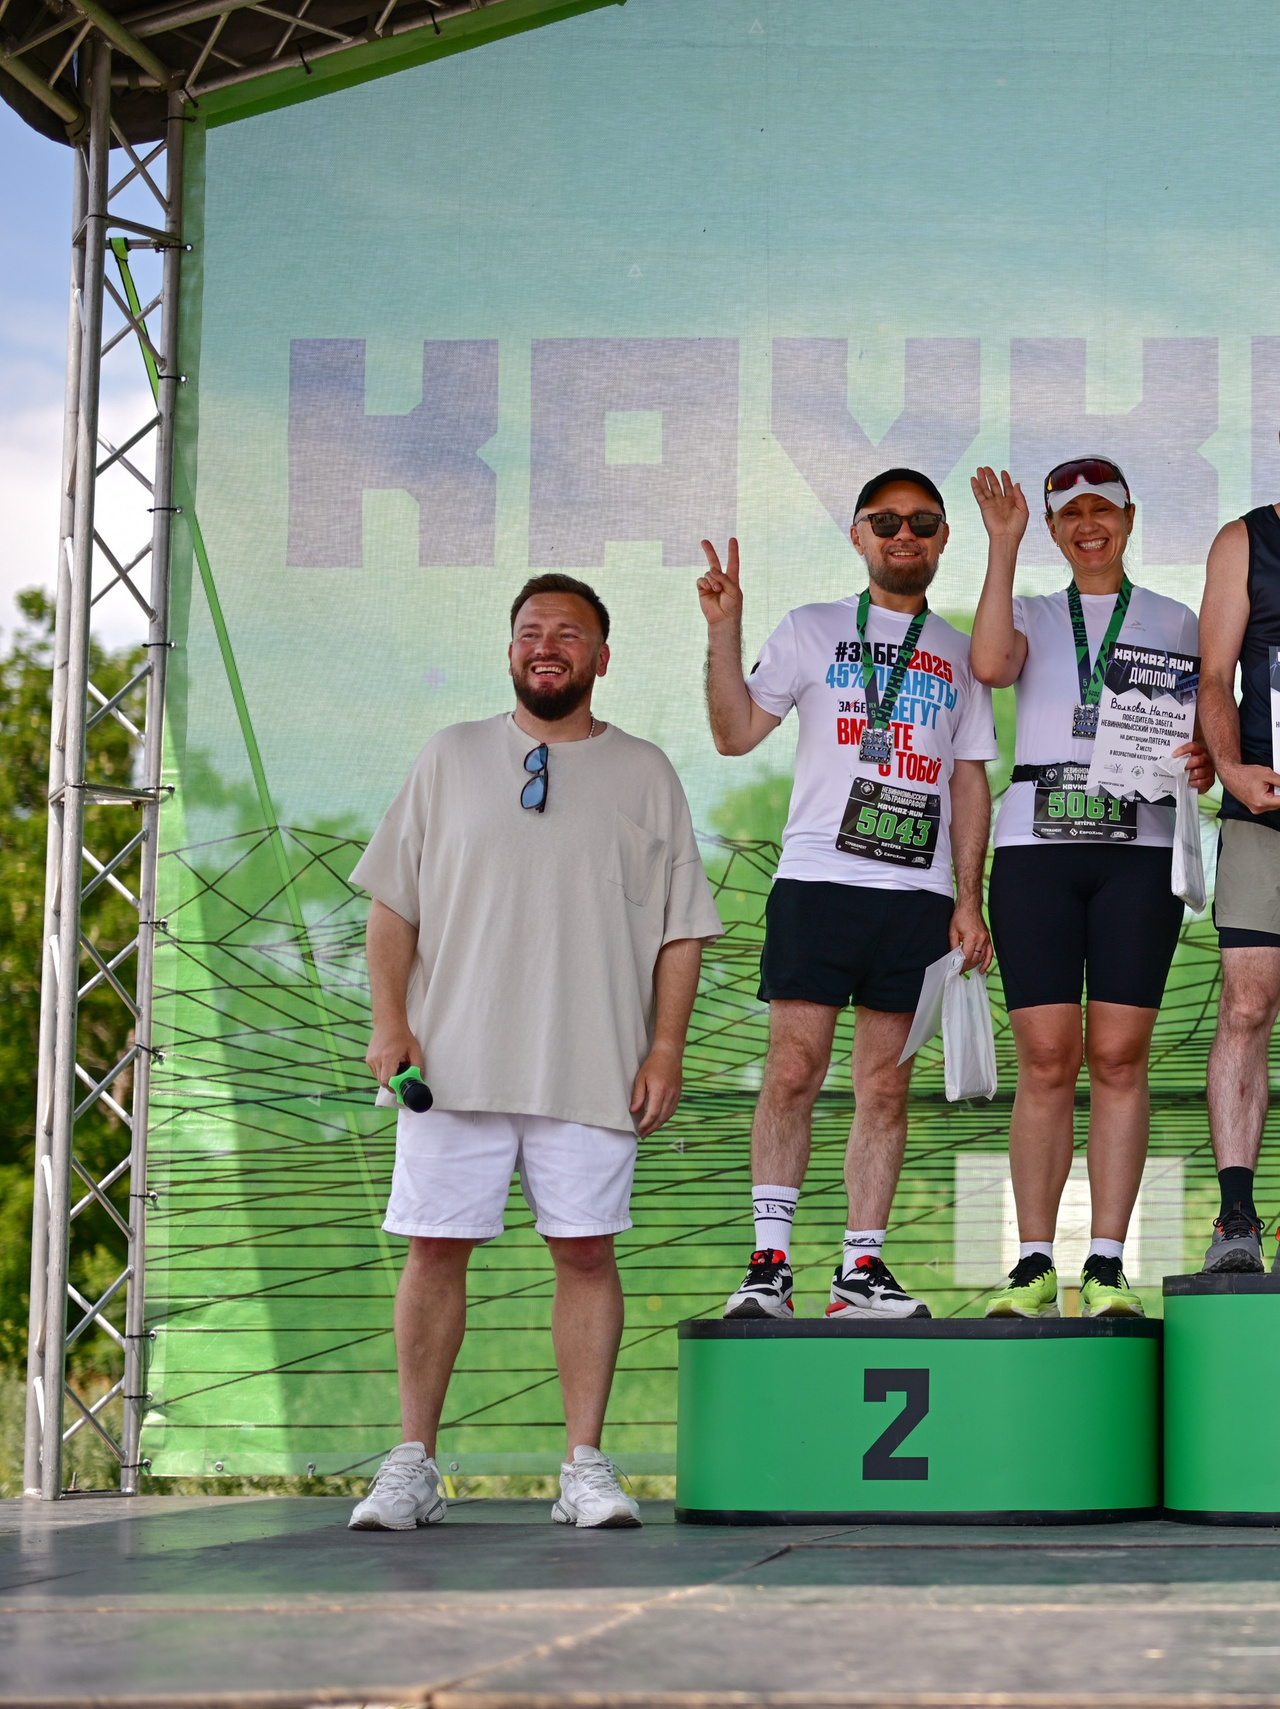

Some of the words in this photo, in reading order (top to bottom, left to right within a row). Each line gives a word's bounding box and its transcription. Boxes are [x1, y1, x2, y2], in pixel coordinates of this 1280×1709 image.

[836, 642, 952, 683] #ЗАБЕ2025
[826, 663, 866, 689] 45%
[874, 668, 958, 712] ПАНЕТЫ
[1129, 667, 1176, 690] ДИПЛОМ
[838, 700, 867, 713] ЗАБЕ
[1110, 698, 1146, 714] Волкова
[1150, 704, 1186, 720] Наталья
[1100, 719, 1148, 732] НЕВИННОМЫССКИЙ
[1150, 726, 1190, 739] УЛЬТРАМАРАФОН
[1122, 714, 1154, 724] ПОБЕДИТЕЛЬ
[1155, 719, 1172, 728] ЗАБЕГА
[836, 718, 914, 751] ВМТЕ
[1148, 736, 1170, 746] ПЯТЕРКА
[880, 792, 926, 809] УЛЬТРАМАРАФОН
[1048, 792, 1121, 820] 5061
[856, 806, 932, 846] 5043
[862, 1368, 929, 1480] 2
